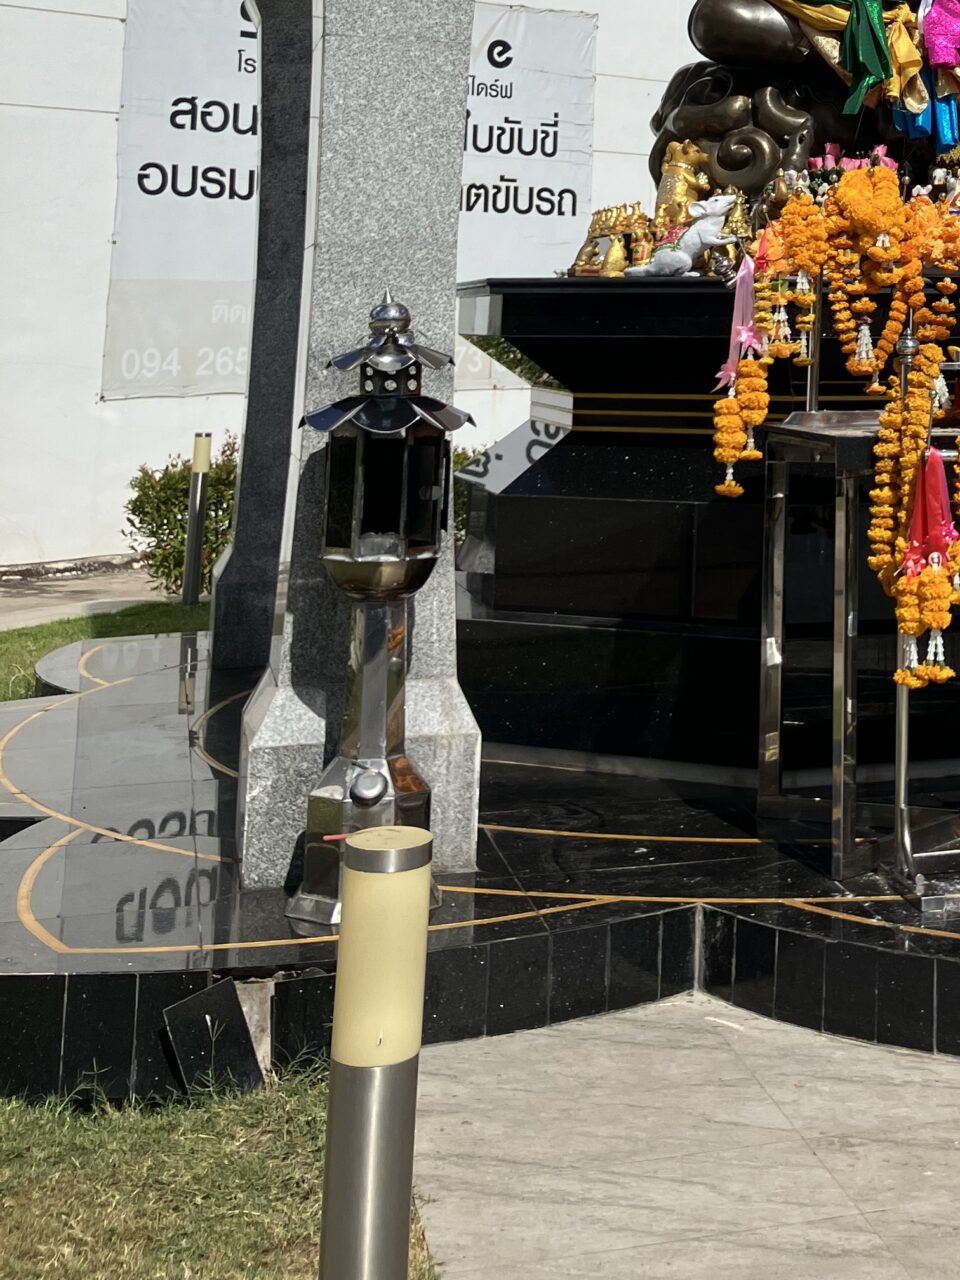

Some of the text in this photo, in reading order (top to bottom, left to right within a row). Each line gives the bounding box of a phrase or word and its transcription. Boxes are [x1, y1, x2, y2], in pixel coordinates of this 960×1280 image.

[467, 75, 513, 99] ไดร์ฟ
[170, 96, 258, 135] สอน
[137, 162, 577, 216] อบรม ตขับรถ
[211, 299, 251, 324] ติด
[121, 347, 181, 379] 094
[195, 346, 249, 376] 265
